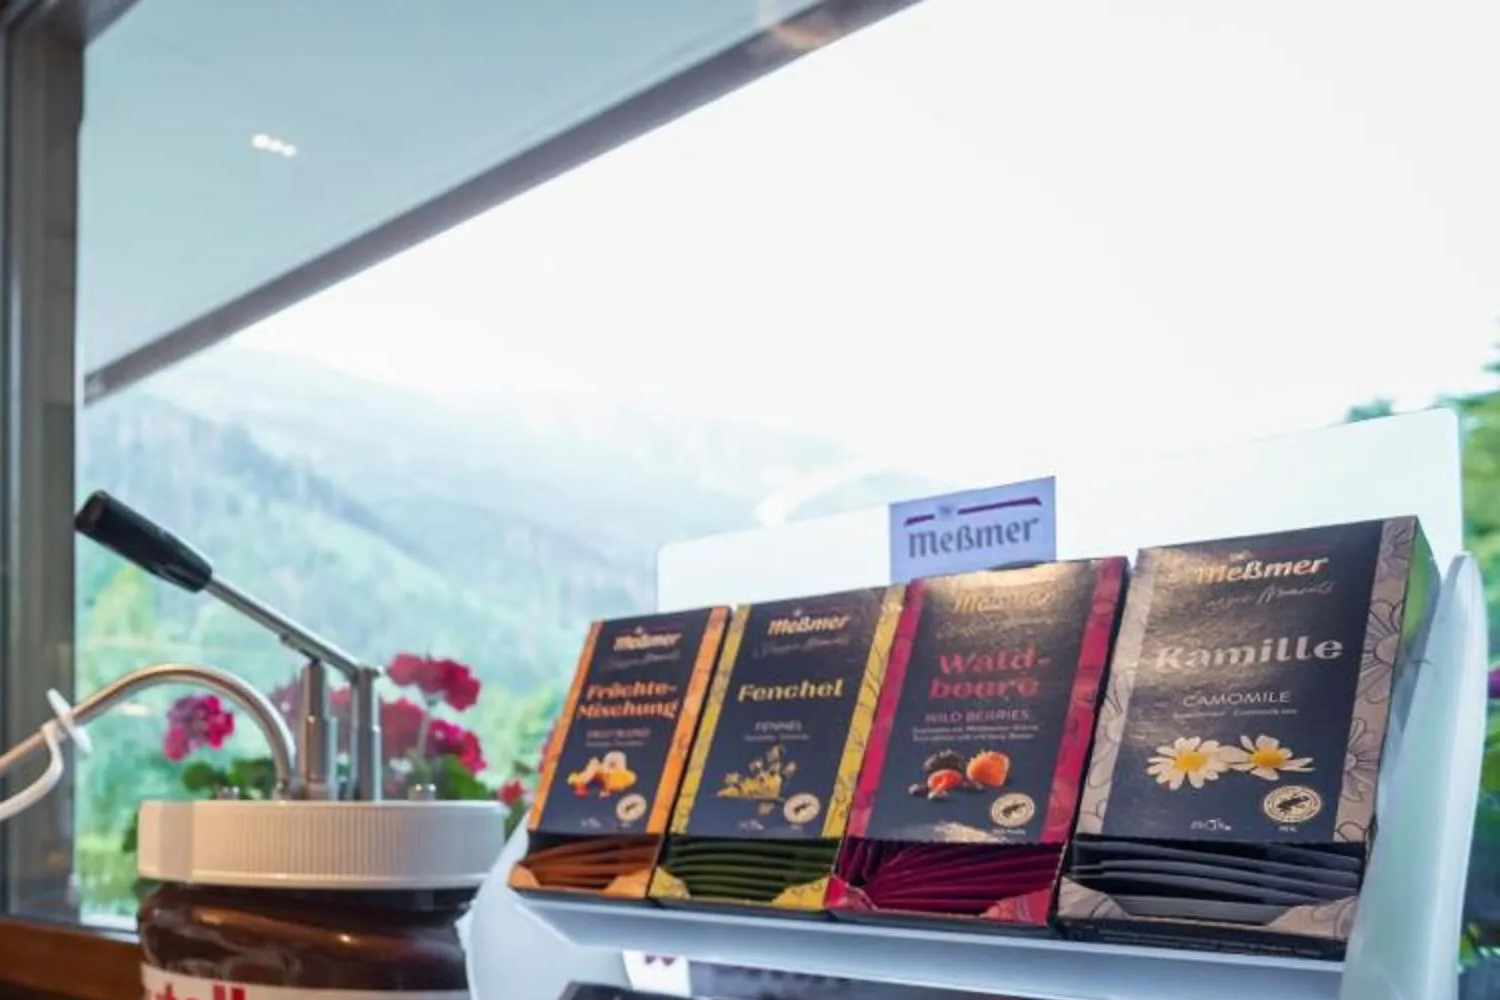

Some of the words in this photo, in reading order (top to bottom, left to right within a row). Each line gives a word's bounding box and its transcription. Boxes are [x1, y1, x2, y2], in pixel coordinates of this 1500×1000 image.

[907, 516, 1041, 558] Meßmer
[1155, 635, 1344, 674] Kamille
[737, 677, 845, 703] Fenchel
[1182, 690, 1291, 708] CAMOMILE
